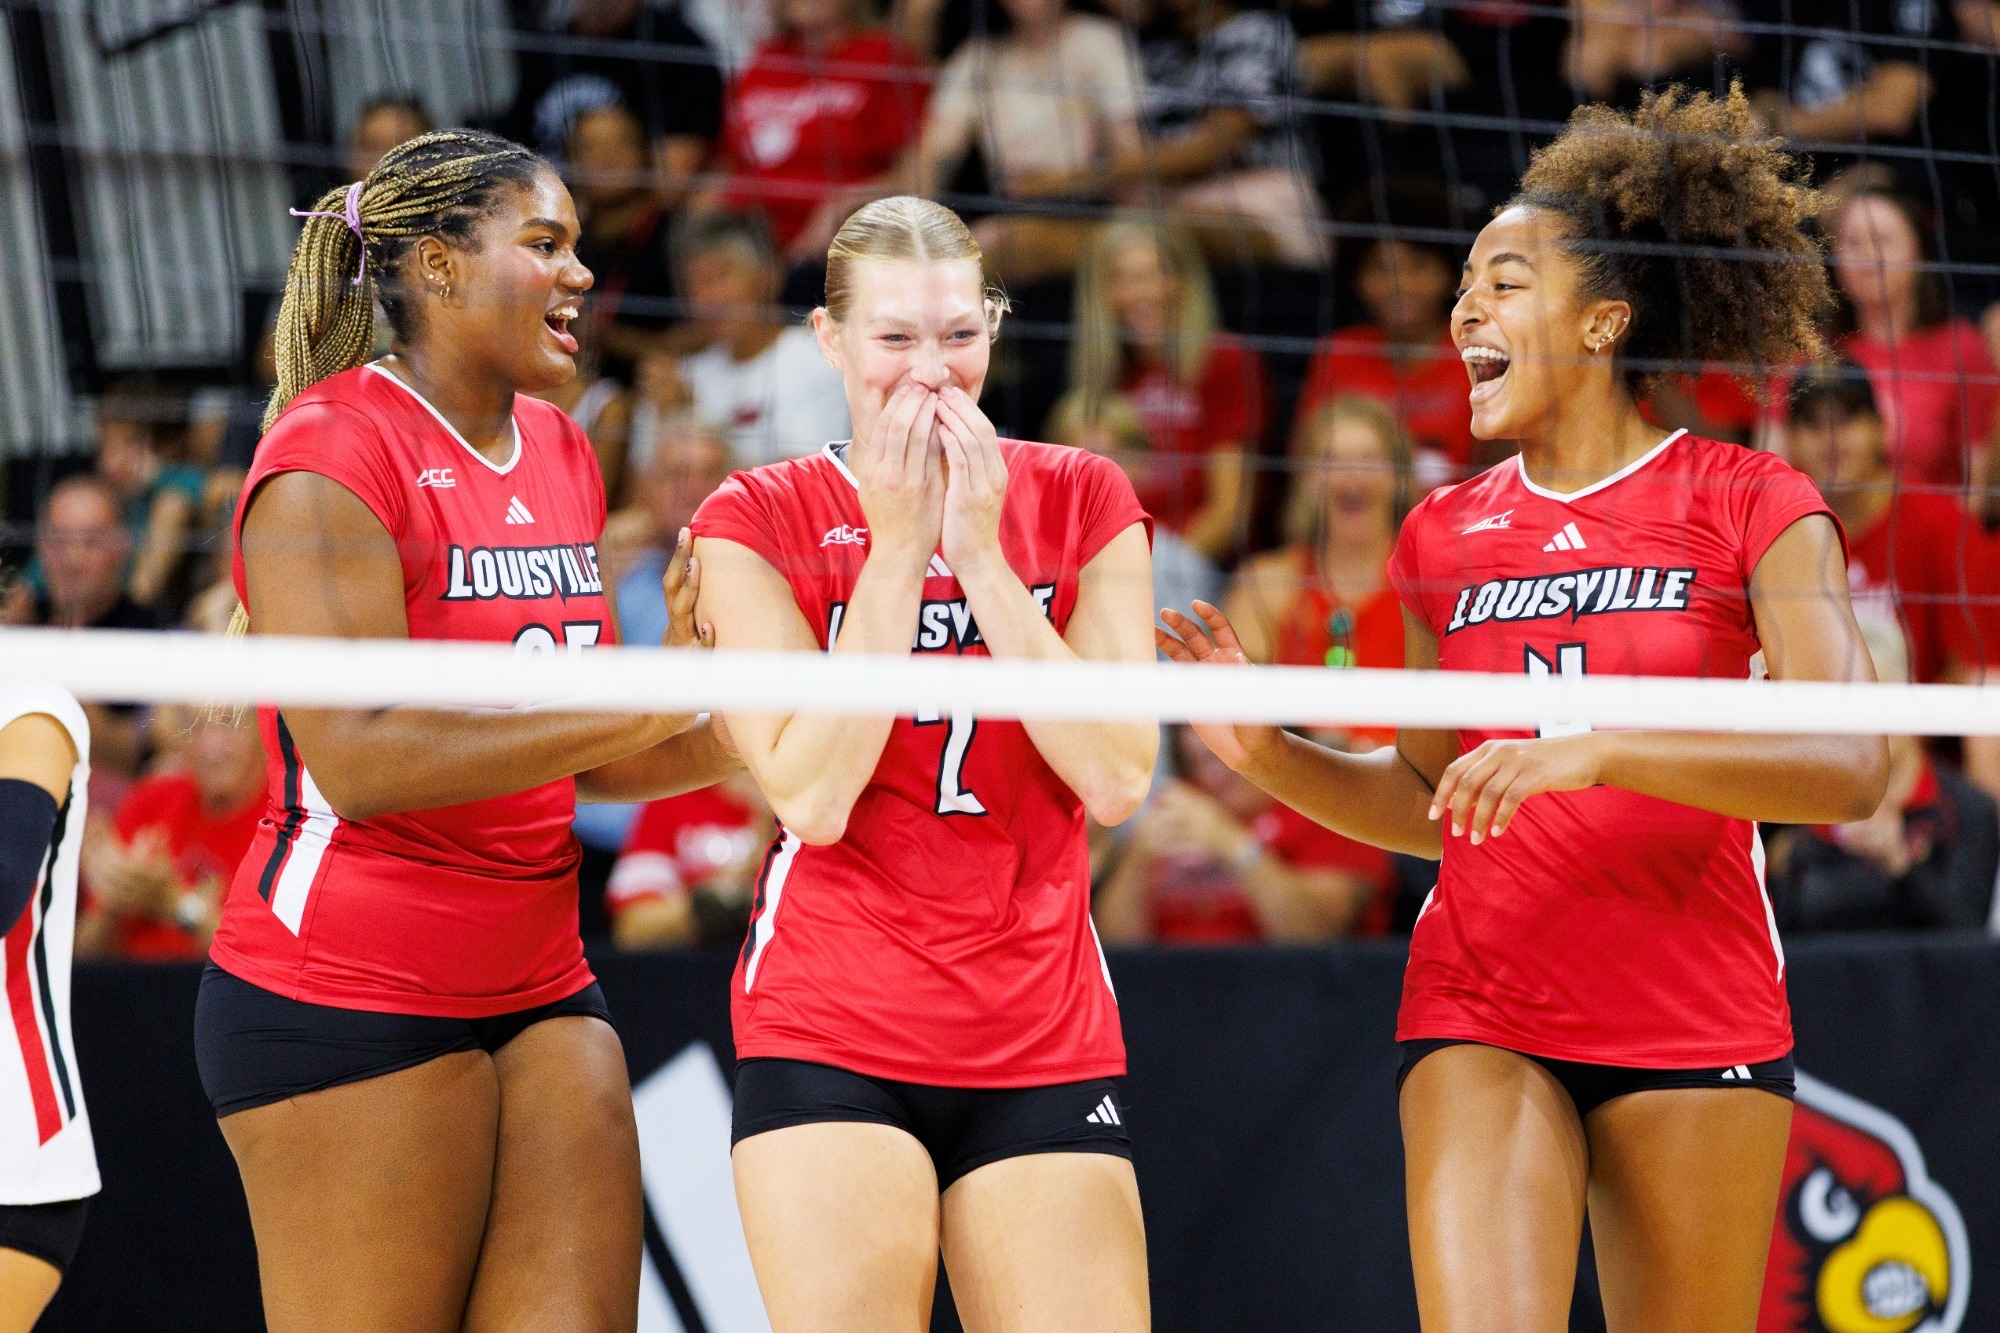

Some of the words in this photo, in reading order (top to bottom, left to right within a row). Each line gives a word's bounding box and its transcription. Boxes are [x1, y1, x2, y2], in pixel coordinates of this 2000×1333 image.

[417, 468, 456, 488] ACC
[819, 523, 869, 548] ACC
[1461, 509, 1515, 536] ACC
[1446, 566, 1697, 634] LOUISVILLE
